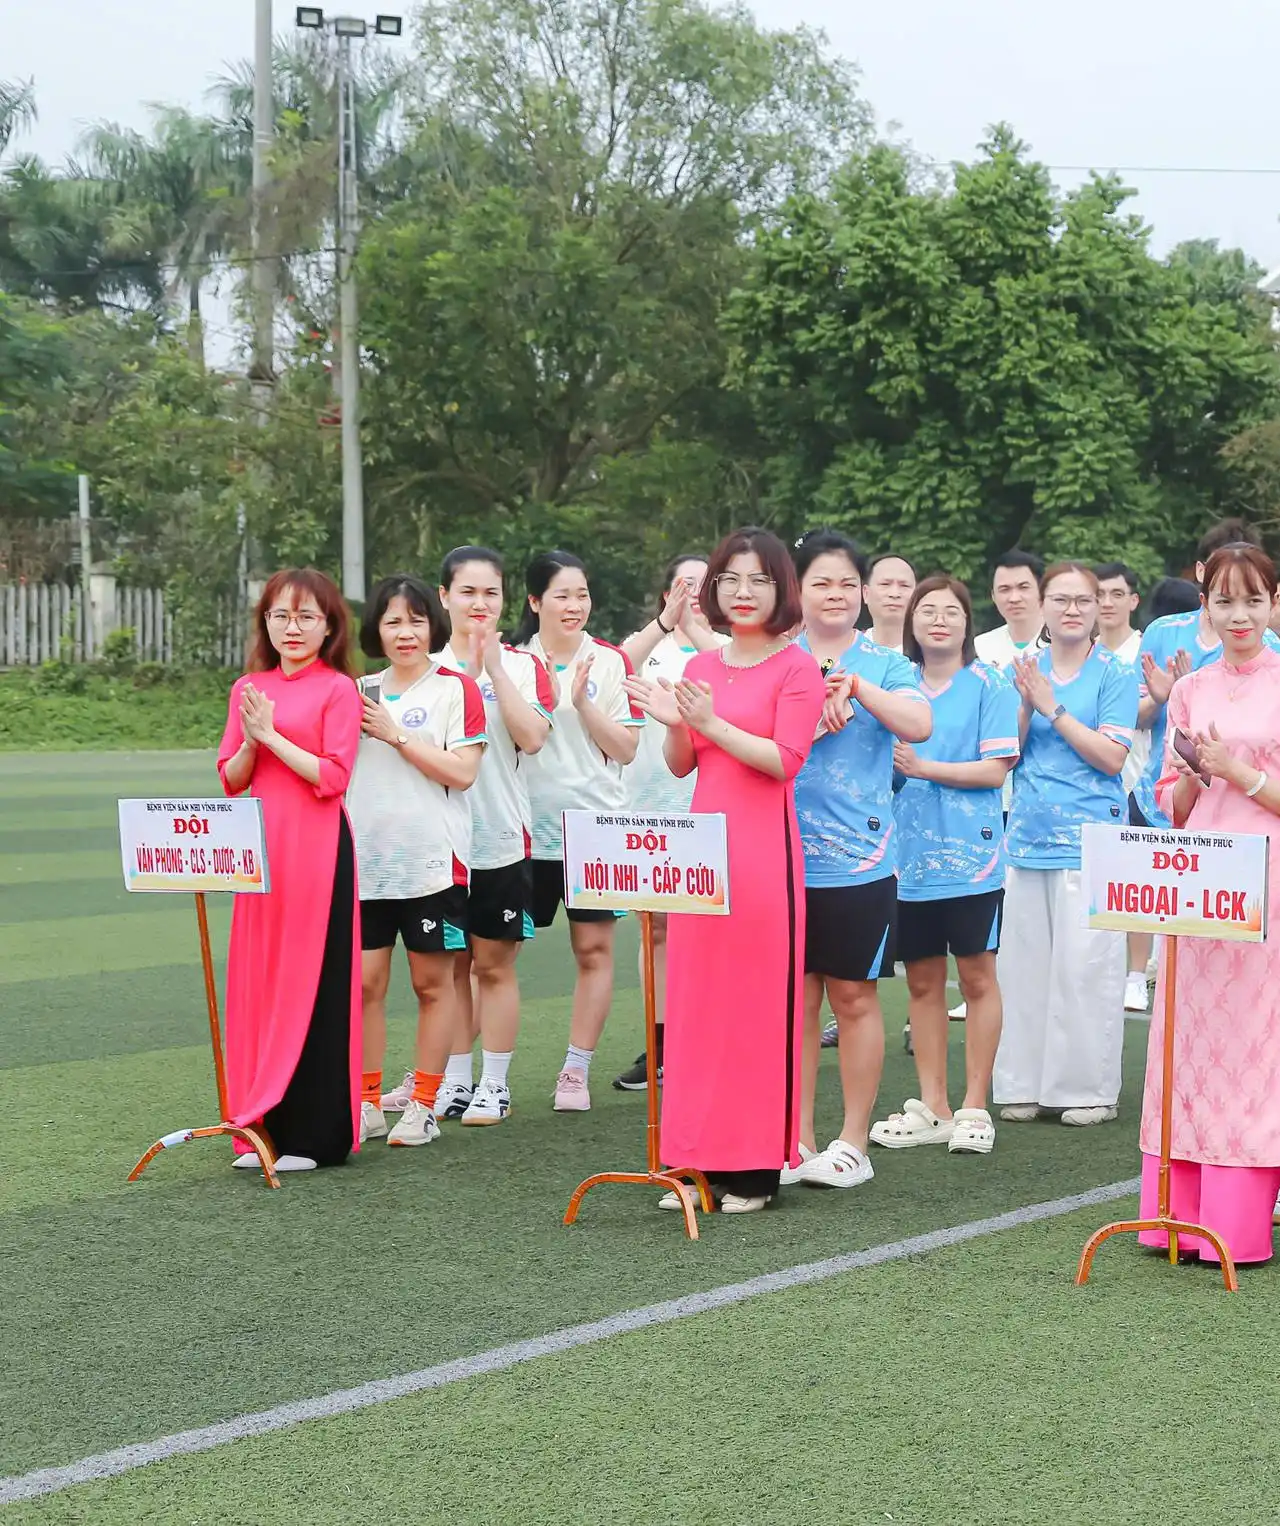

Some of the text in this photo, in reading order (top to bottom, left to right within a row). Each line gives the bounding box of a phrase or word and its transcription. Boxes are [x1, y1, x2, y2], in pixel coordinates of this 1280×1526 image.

[173, 814, 210, 839] ĐỘI
[646, 818, 659, 828] NHI
[626, 829, 668, 856] ĐỘI
[1120, 830, 1140, 844] BỆNH
[1141, 831, 1160, 845] VIỆN
[1177, 836, 1191, 845] NHI
[1212, 837, 1233, 848] PHÚC
[136, 843, 154, 872] VĂN
[190, 848, 206, 873] CLS
[213, 845, 235, 880] DƯỢC
[242, 849, 255, 874] KB
[1152, 848, 1200, 876] ĐỘI
[584, 857, 610, 897] NỘI
[613, 864, 638, 892] NHI
[652, 857, 681, 893] CẤP
[686, 862, 715, 896] CỨU
[1107, 881, 1178, 922] NGOẠI
[1202, 889, 1247, 921] LCK
